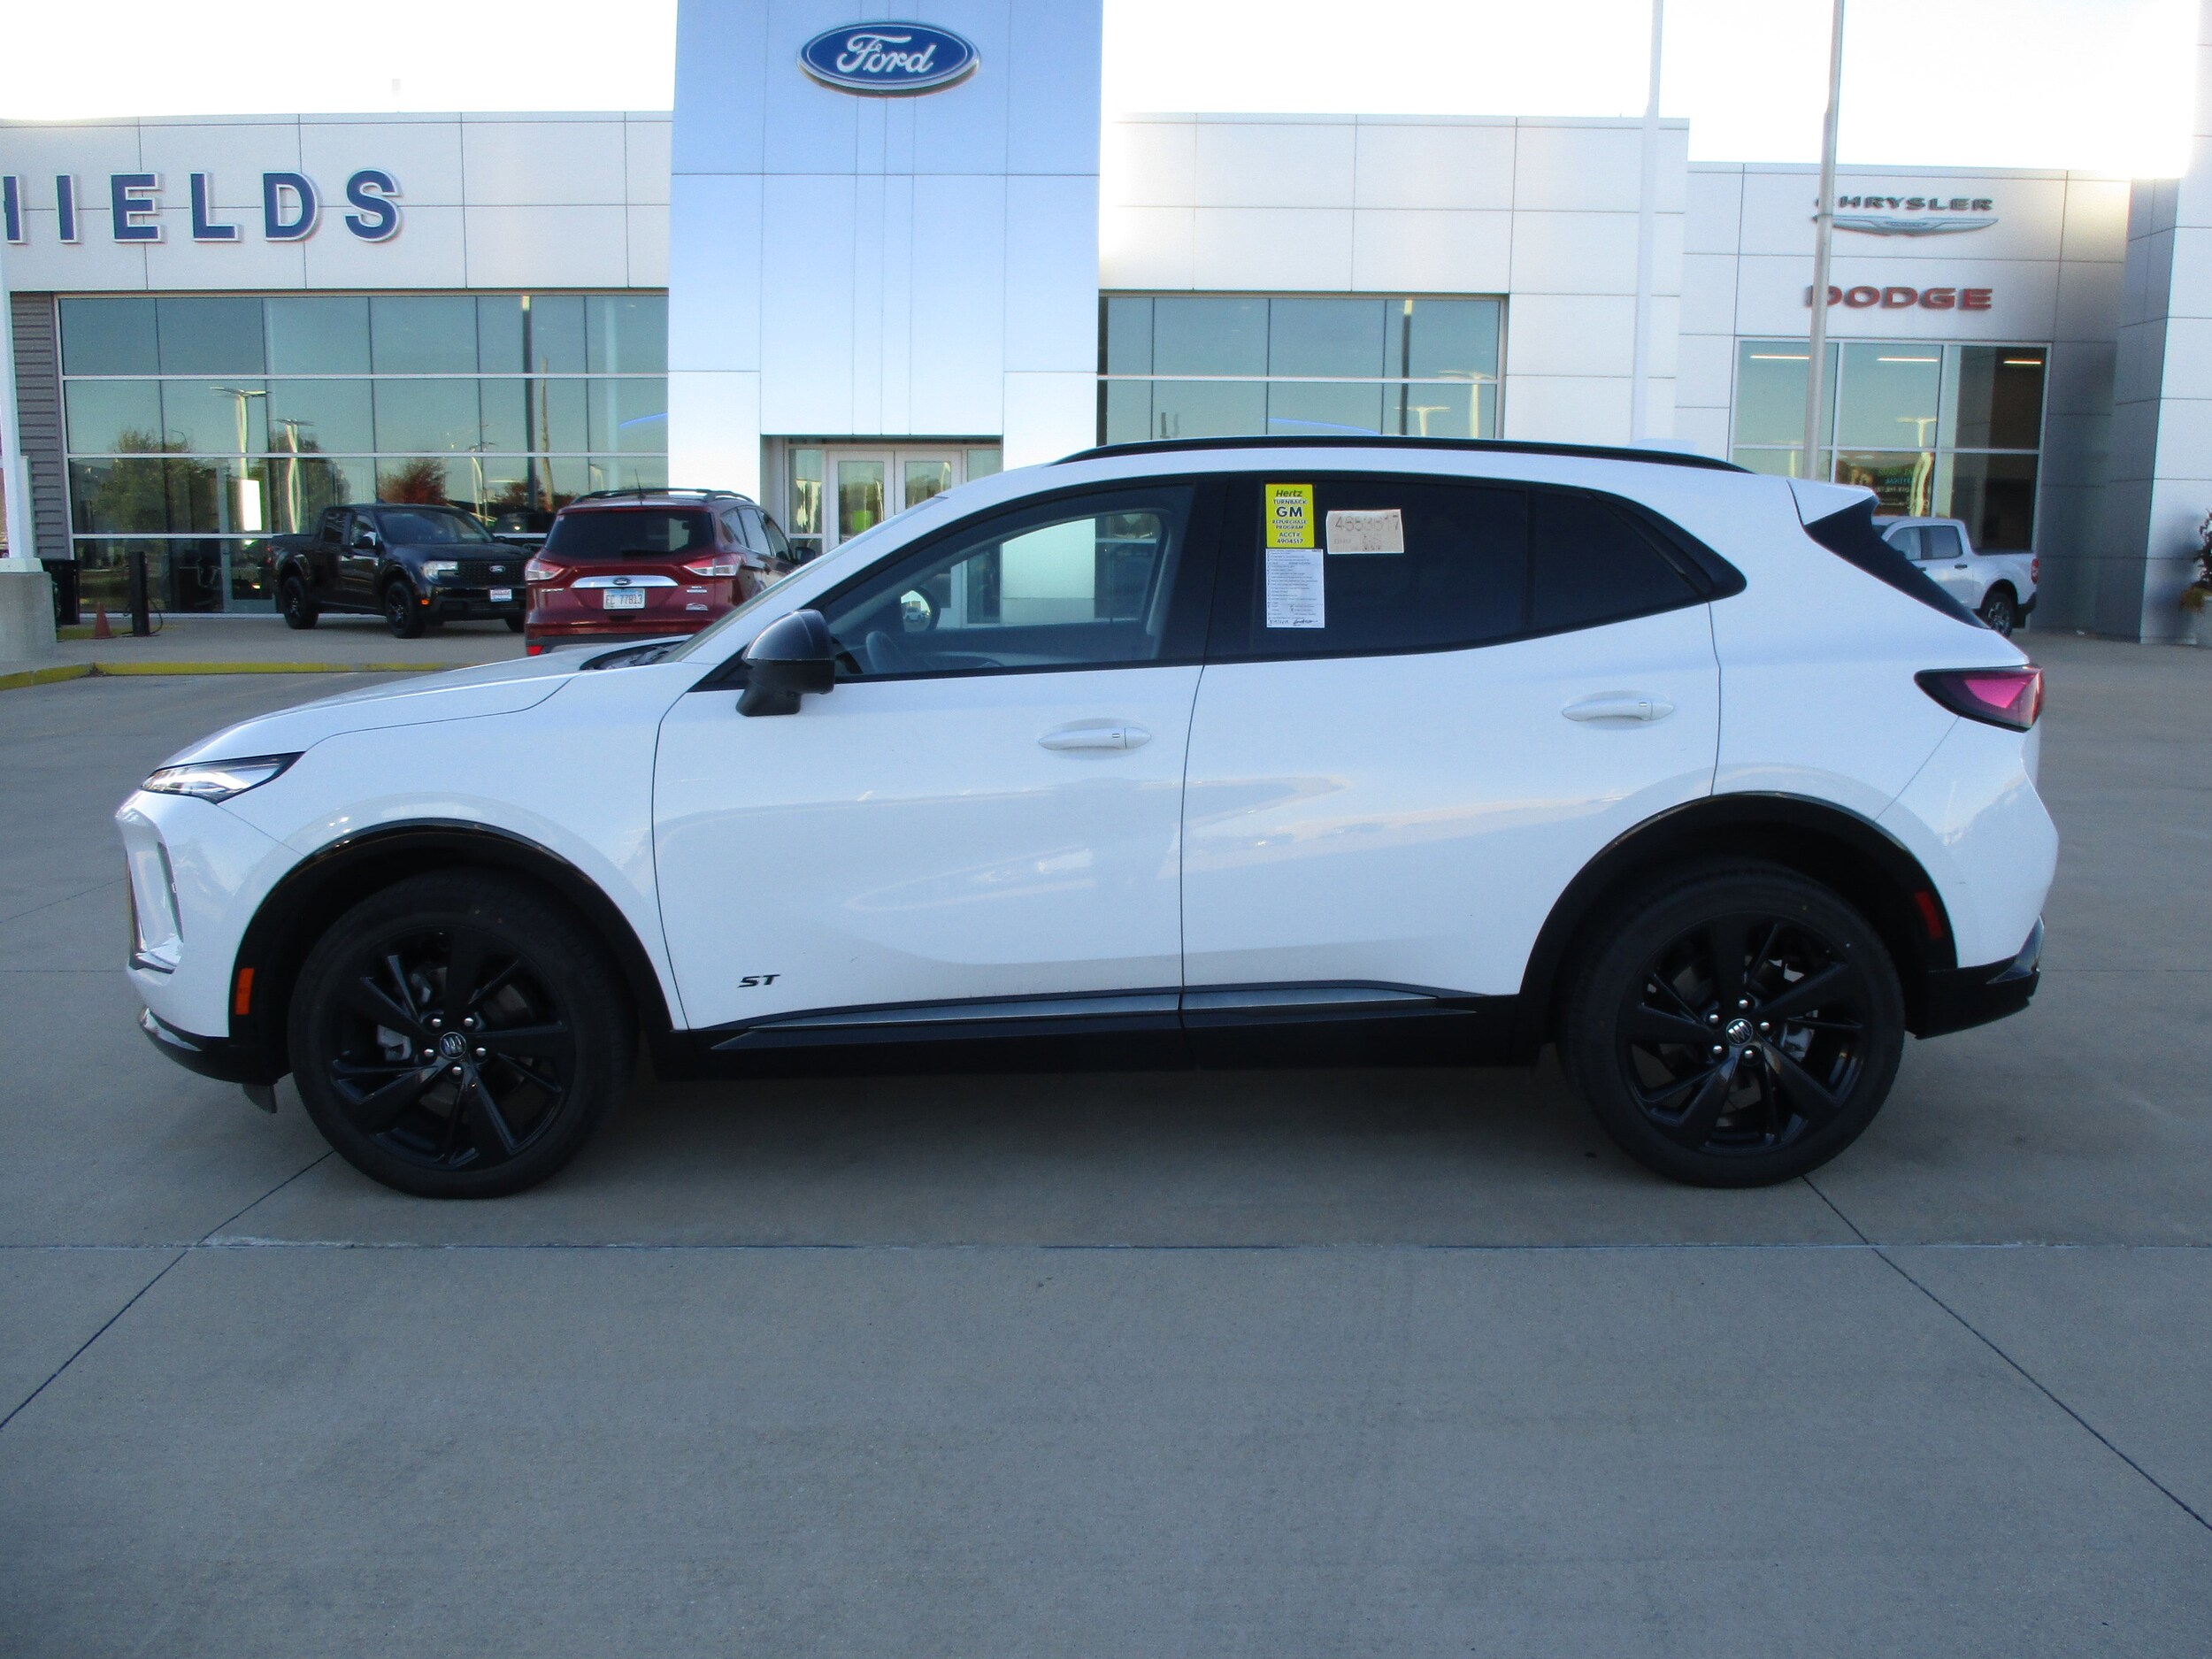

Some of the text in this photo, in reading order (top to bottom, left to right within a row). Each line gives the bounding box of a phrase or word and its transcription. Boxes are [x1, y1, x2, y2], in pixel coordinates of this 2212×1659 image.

[835, 34, 937, 73] Ford
[1816, 196, 1993, 211] HRYSLER
[1276, 506, 1302, 518] GM
[737, 974, 780, 987] ST
